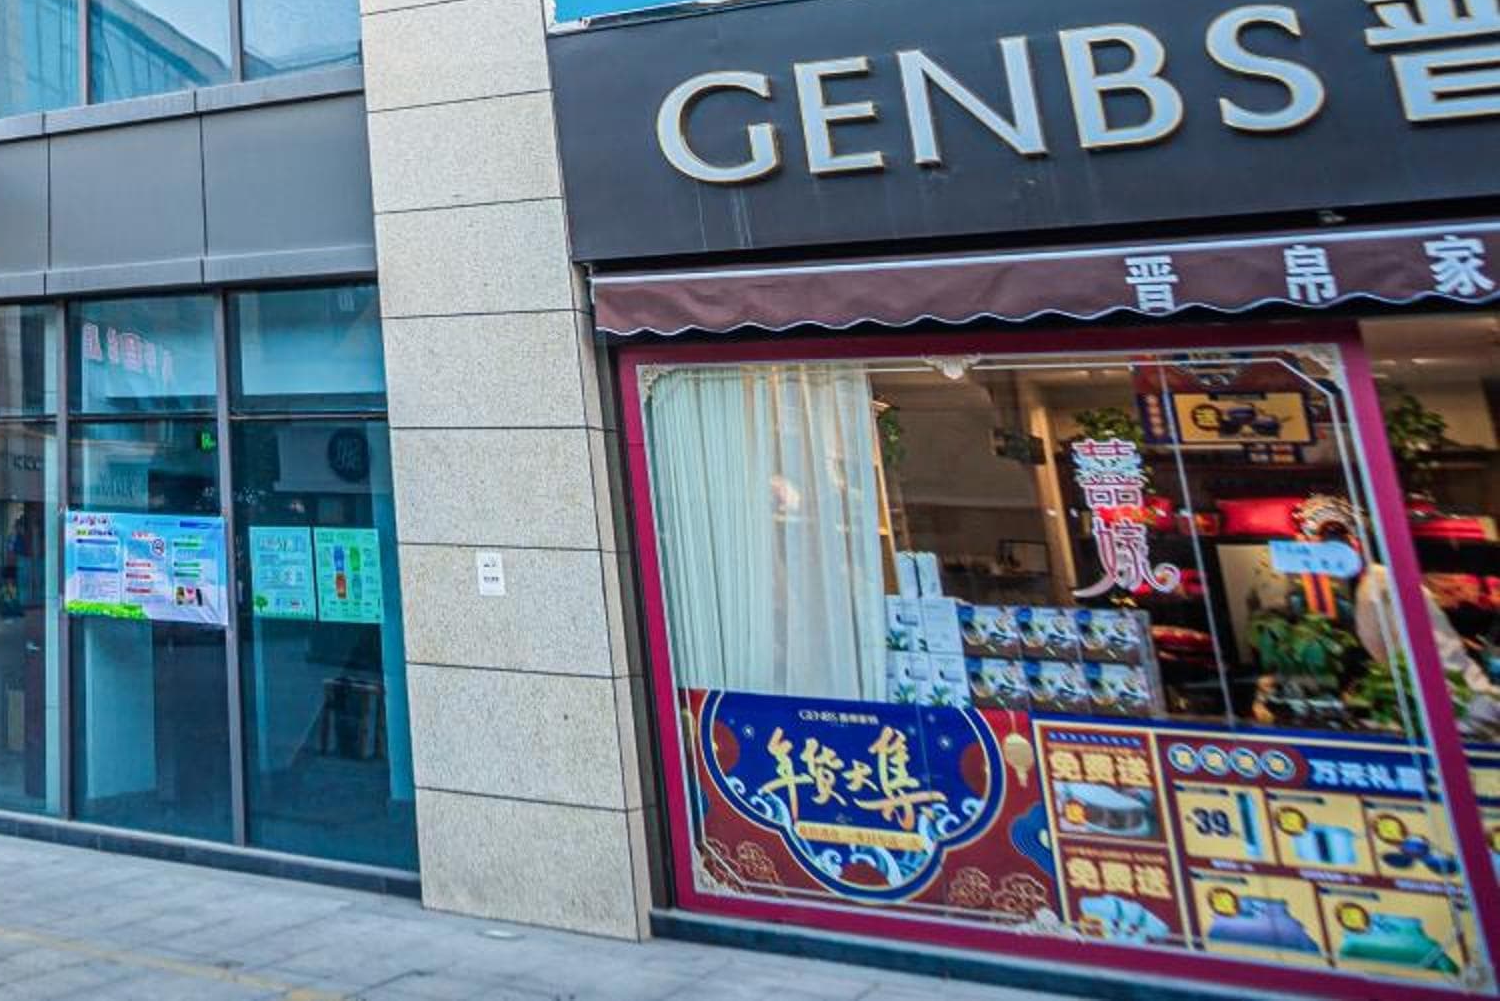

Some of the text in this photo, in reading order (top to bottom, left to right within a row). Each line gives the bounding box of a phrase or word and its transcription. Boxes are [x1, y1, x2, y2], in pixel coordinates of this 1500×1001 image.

[656, 3, 1327, 186] GENBS
[757, 725, 948, 831] 年货大集
[1049, 750, 1153, 789] 免费送
[1192, 806, 1233, 837] 39
[1066, 855, 1173, 901] 免费送
